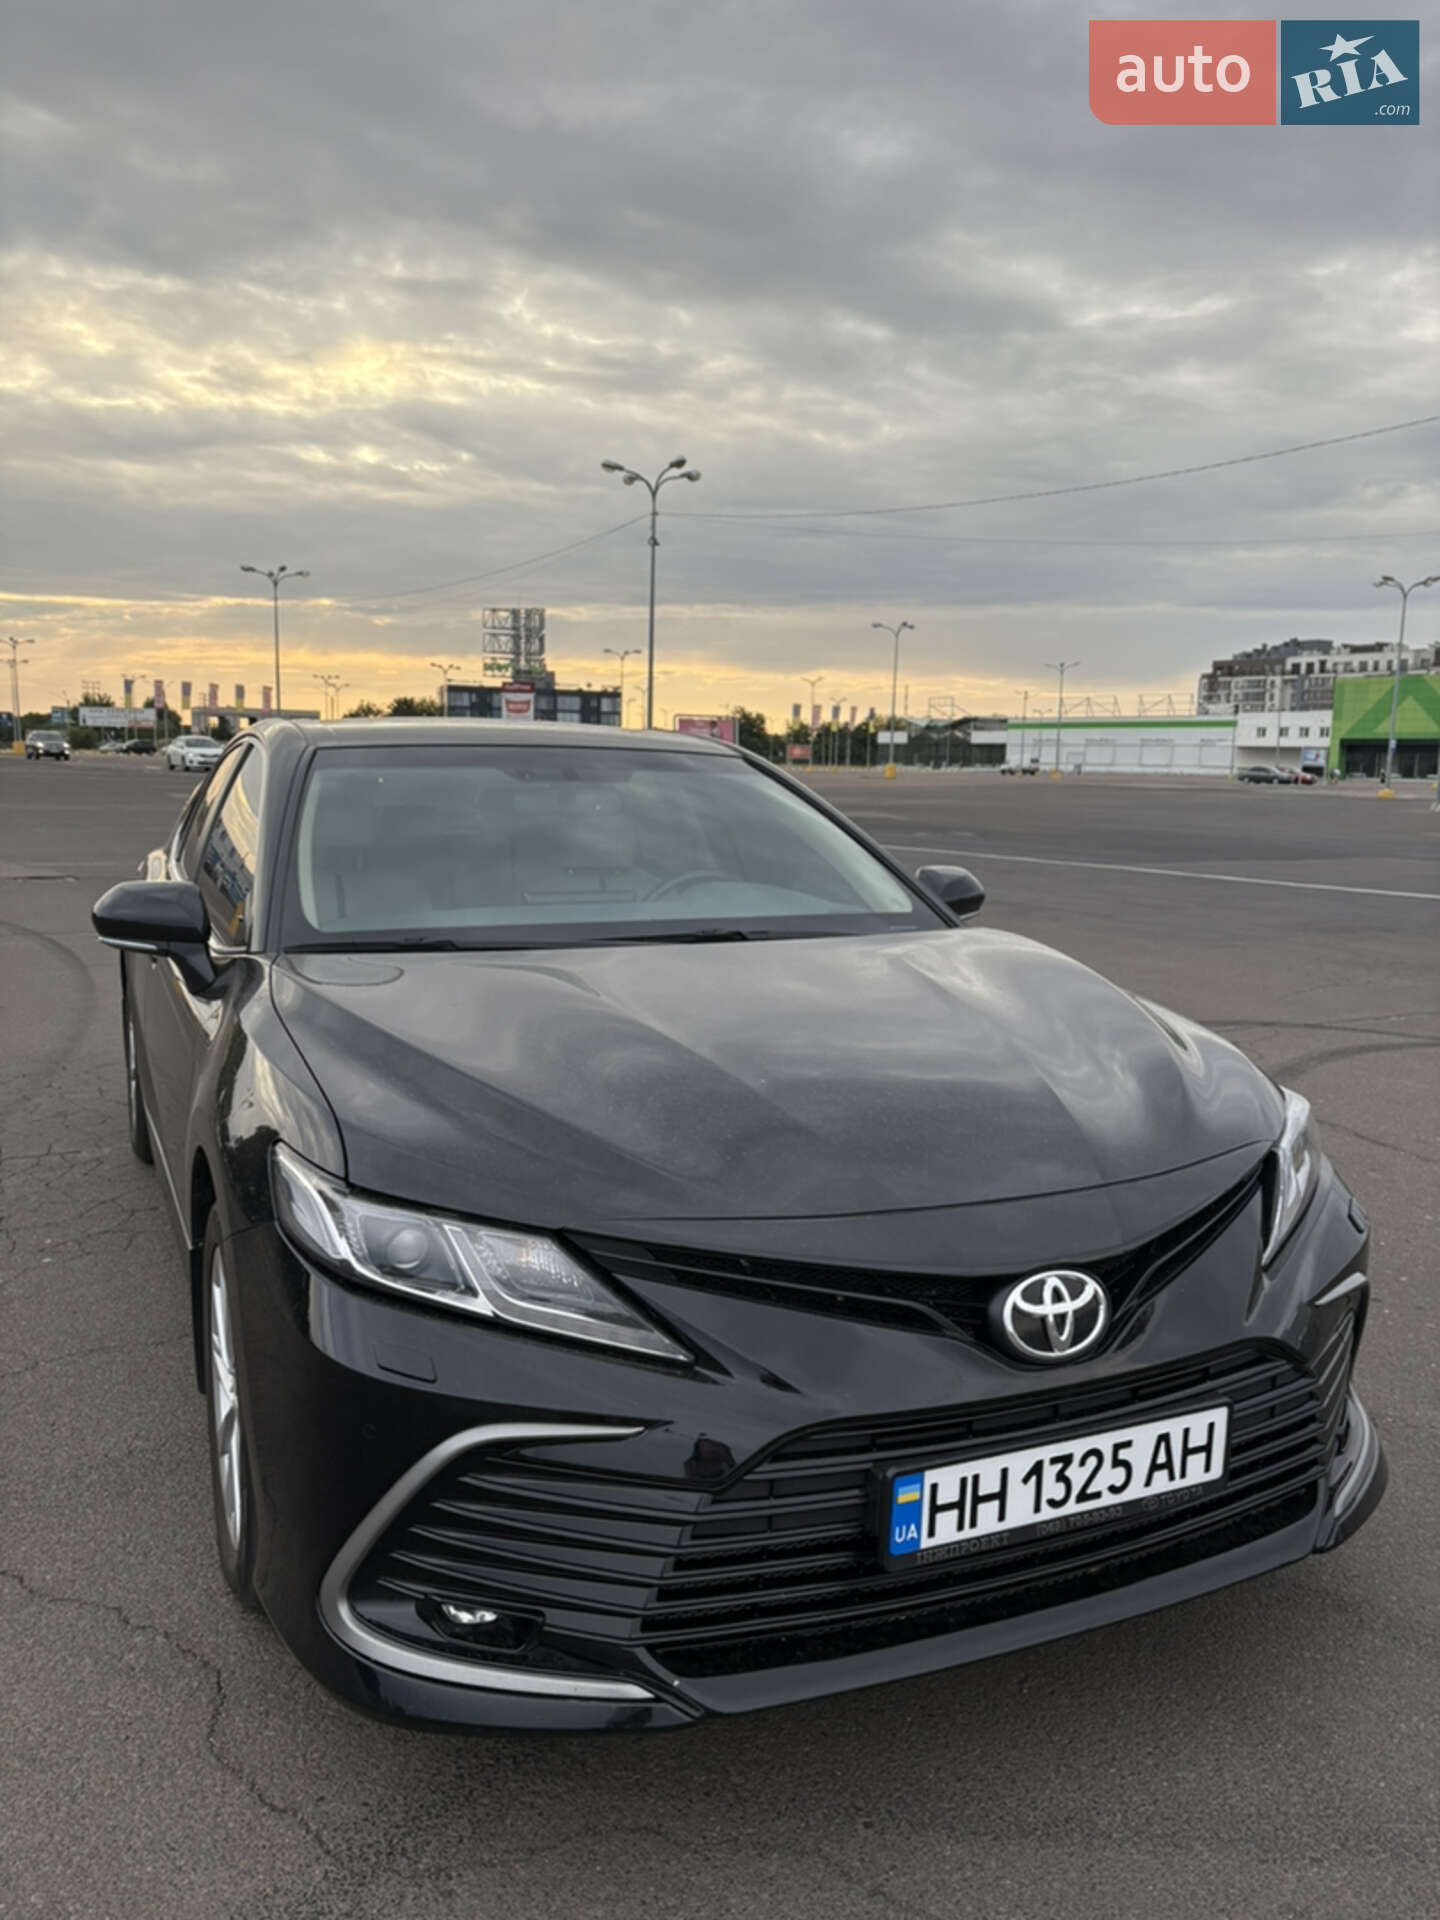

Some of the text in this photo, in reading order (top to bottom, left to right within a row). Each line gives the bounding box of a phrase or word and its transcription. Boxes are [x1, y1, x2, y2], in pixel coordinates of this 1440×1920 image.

[928, 1421, 1215, 1538] HH 1325 AH
[1160, 1486, 1204, 1506] TOYOTA
[894, 1523, 919, 1543] UA
